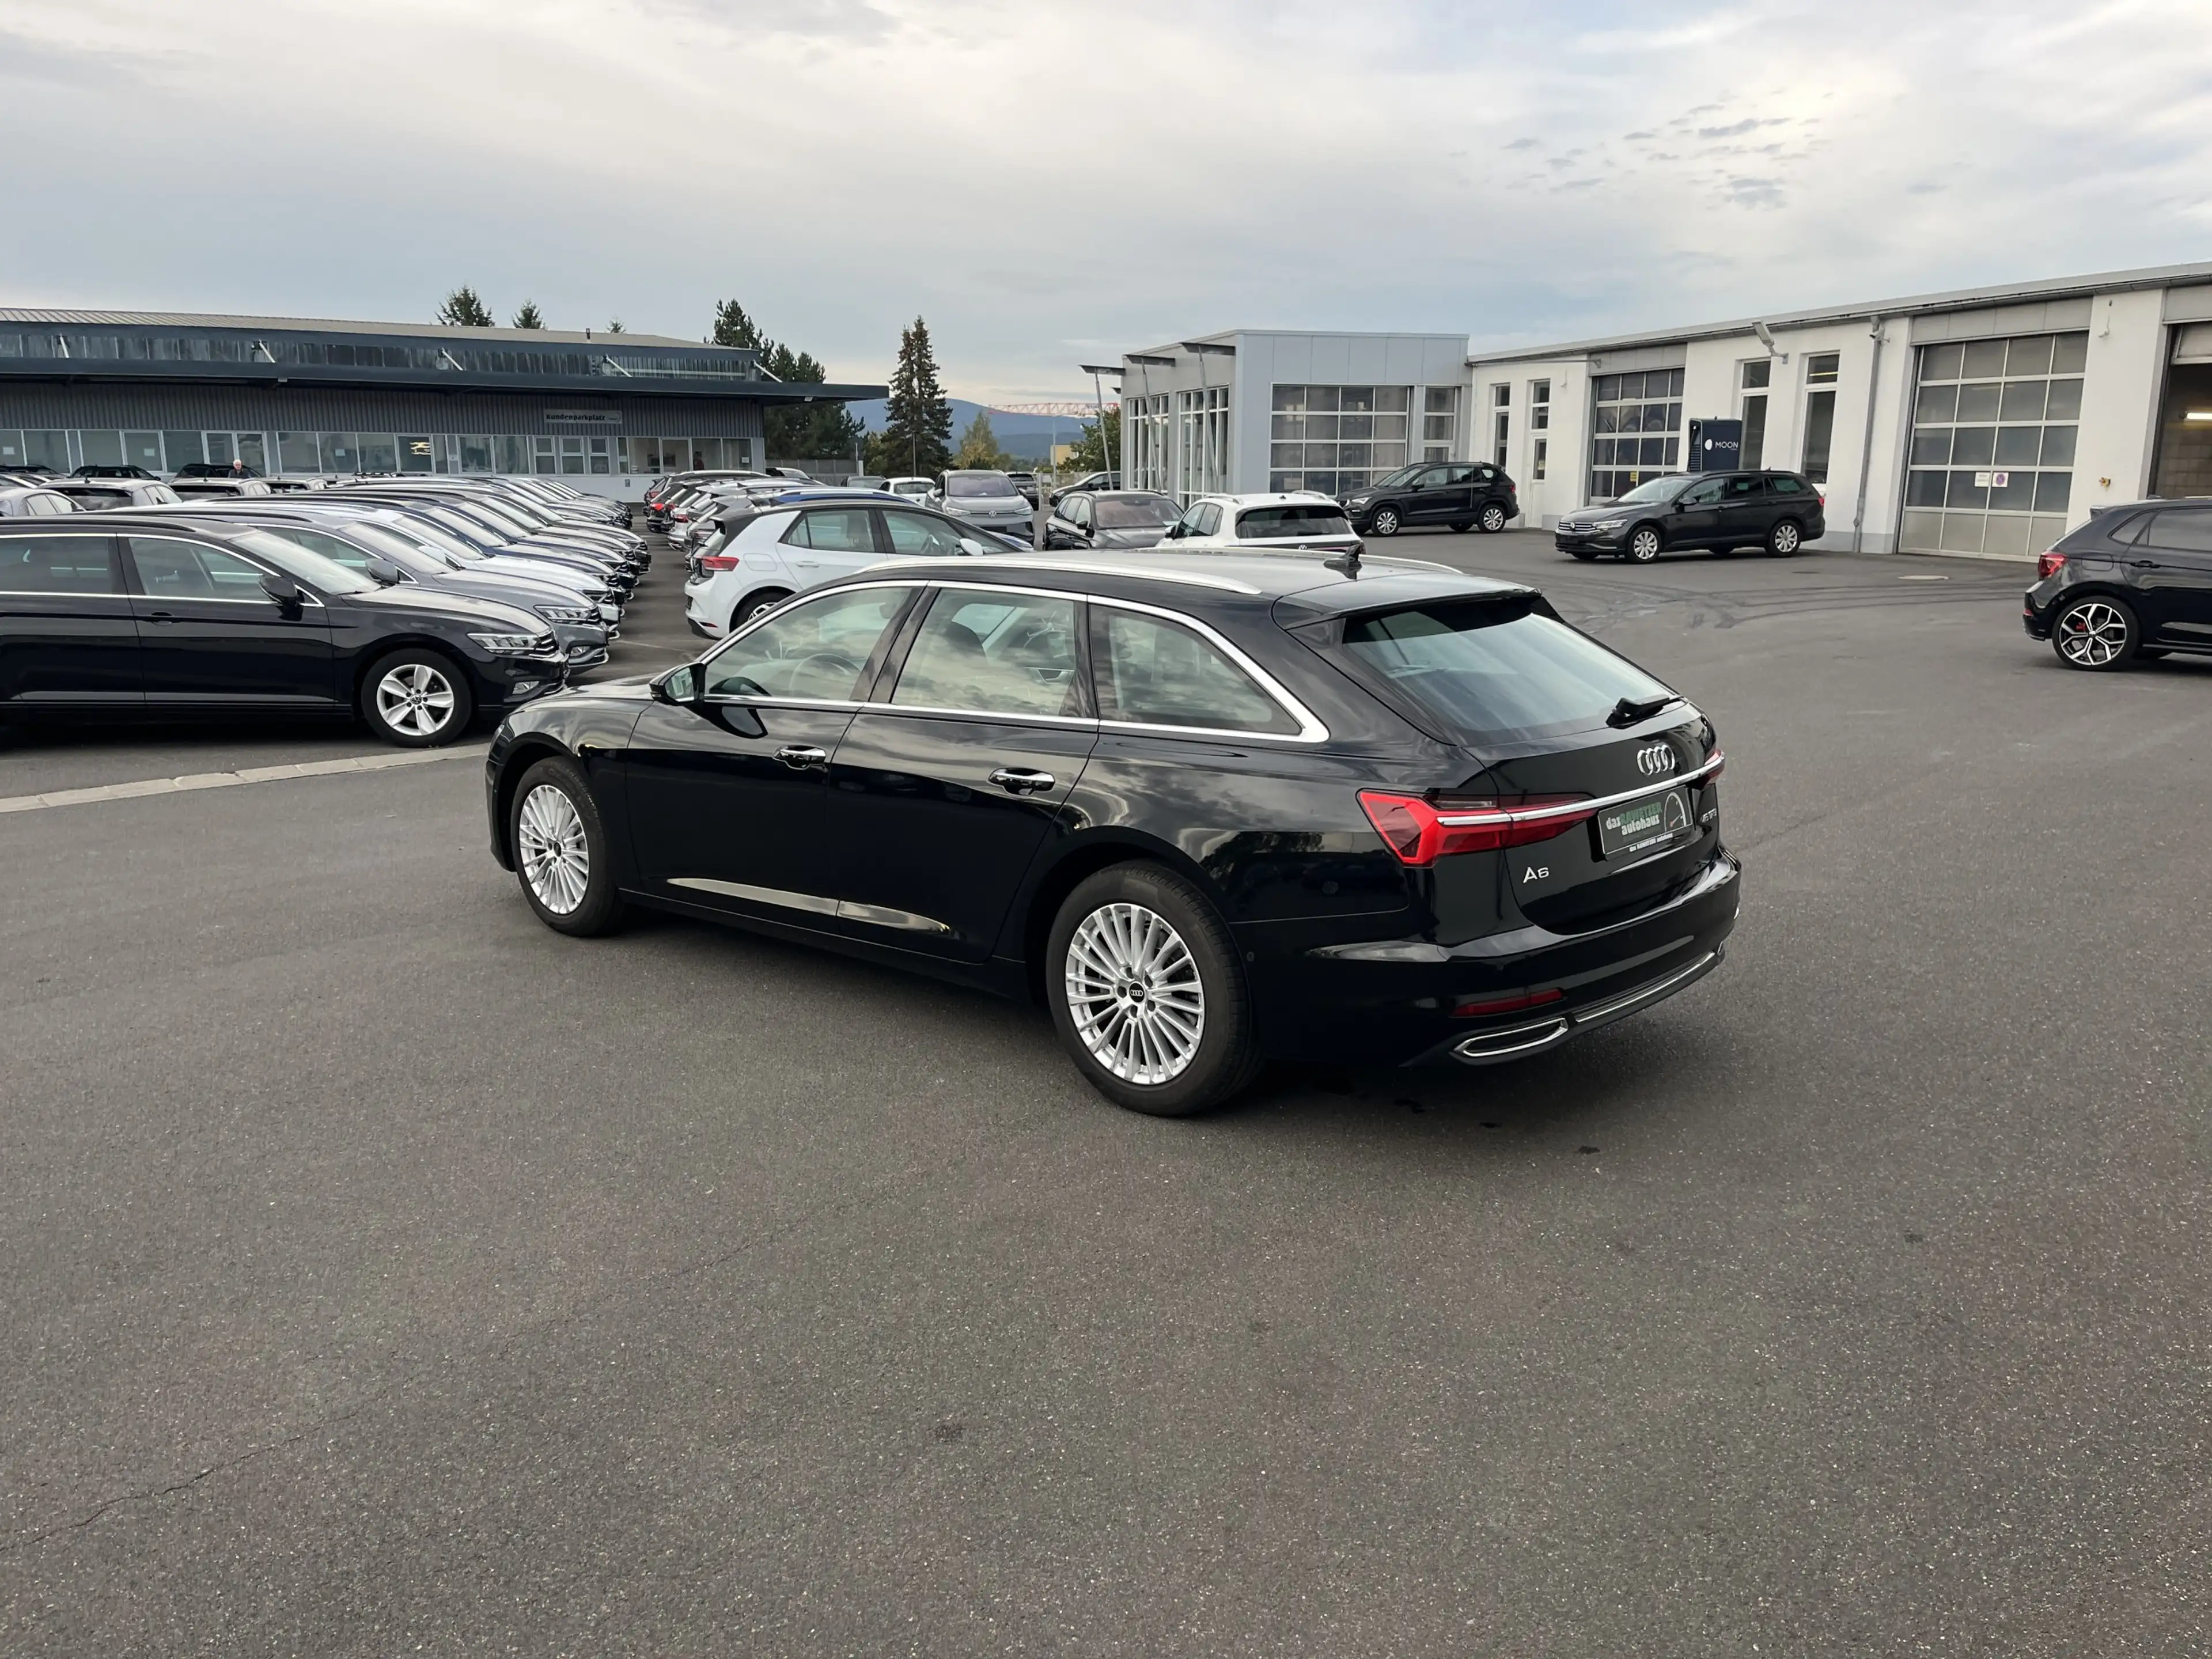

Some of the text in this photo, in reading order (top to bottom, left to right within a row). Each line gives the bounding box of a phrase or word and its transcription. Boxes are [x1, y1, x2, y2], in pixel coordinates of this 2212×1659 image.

[546, 413, 605, 421] Kundenparkplatz
[1621, 814, 1660, 835] autohaus
[1523, 866, 1550, 883] A6
